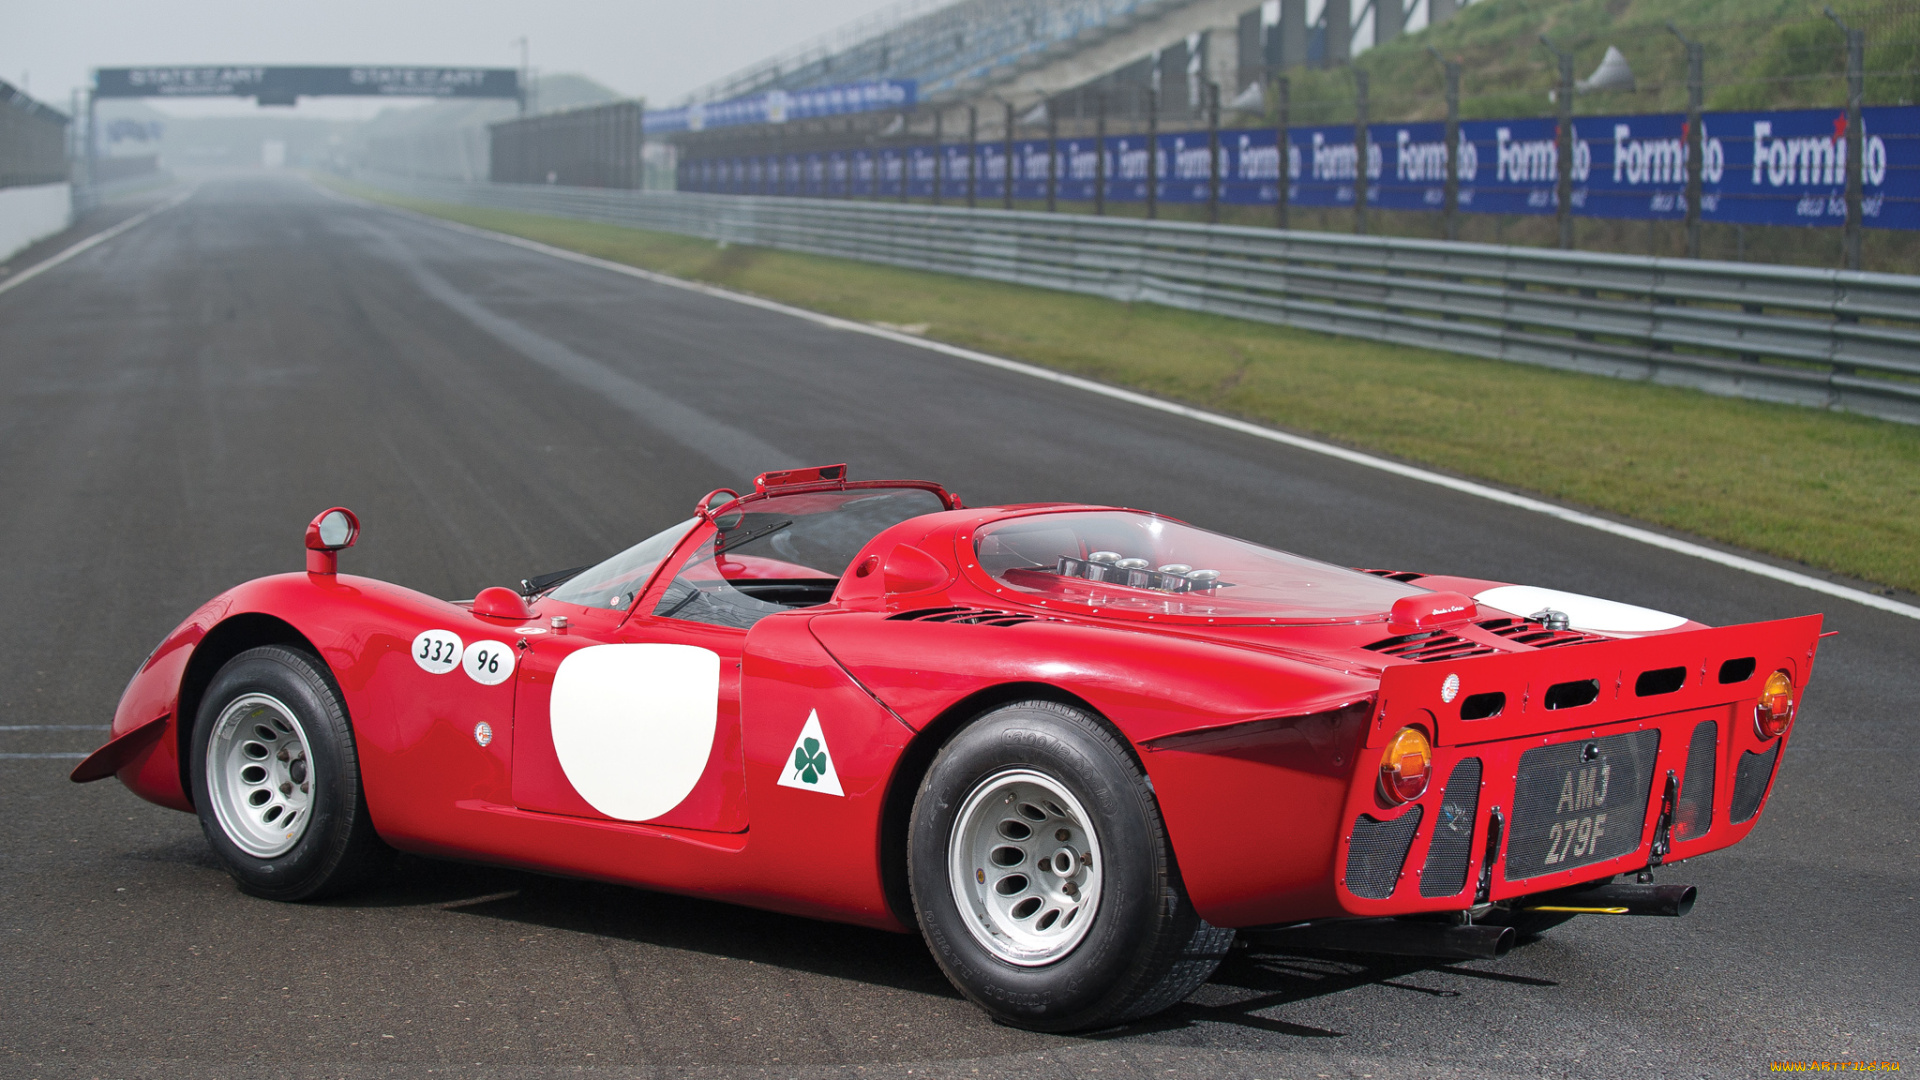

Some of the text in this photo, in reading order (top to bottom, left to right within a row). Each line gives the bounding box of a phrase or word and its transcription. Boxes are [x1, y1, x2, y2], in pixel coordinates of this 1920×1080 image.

[128, 69, 196, 86] STATE
[351, 69, 417, 86] STATE
[1313, 131, 1383, 180] Formdo
[1397, 129, 1478, 182] Formdo
[1497, 124, 1591, 183] Formo
[419, 637, 455, 664] 332
[477, 650, 500, 674] 96
[1555, 764, 1611, 814] AMJ
[1544, 814, 1607, 865] 279F
[983, 984, 1052, 1007] DUNLOP
